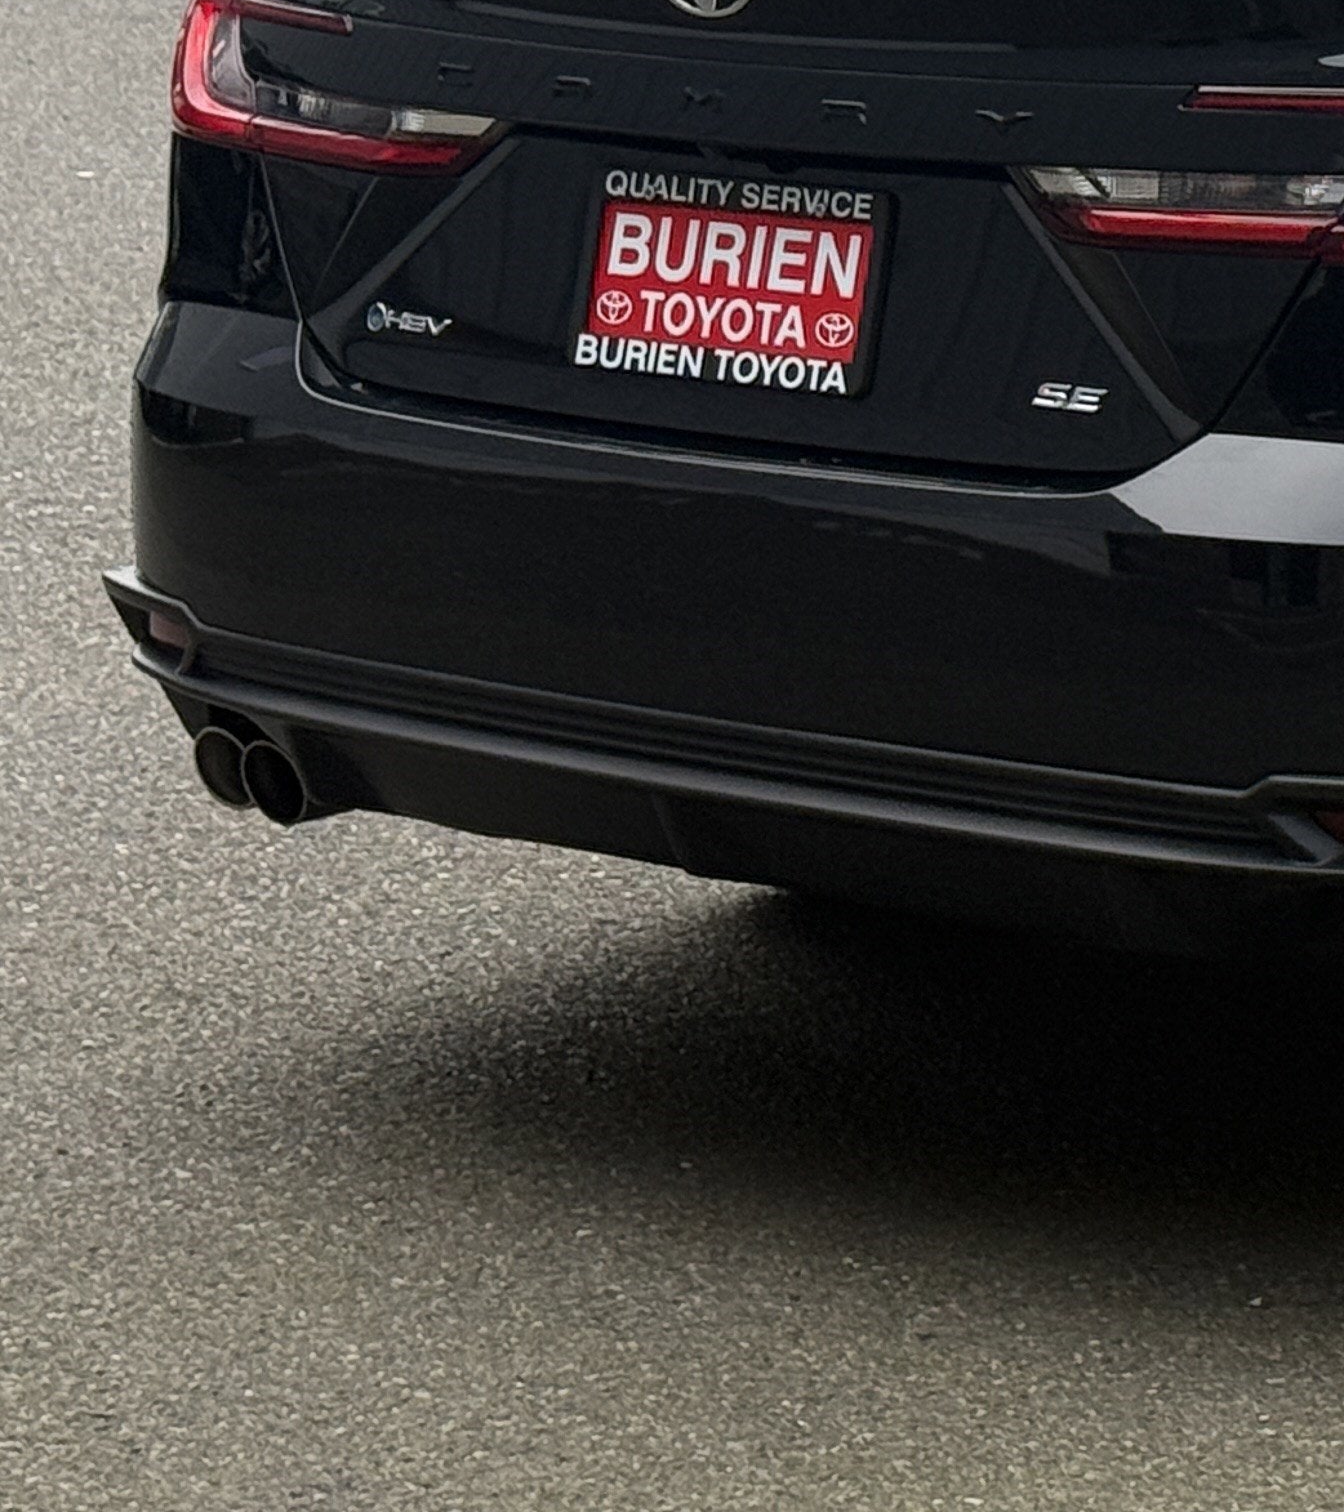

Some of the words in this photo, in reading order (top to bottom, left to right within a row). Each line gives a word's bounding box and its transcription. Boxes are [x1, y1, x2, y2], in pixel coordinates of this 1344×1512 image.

[605, 169, 734, 206] QUALITY
[740, 182, 874, 220] SERVICE
[606, 211, 863, 299] BURIEN
[640, 289, 806, 349] TOYOTA
[574, 333, 704, 378] BURIEN
[713, 348, 847, 394] TOYOTA
[1031, 381, 1110, 414] SE
